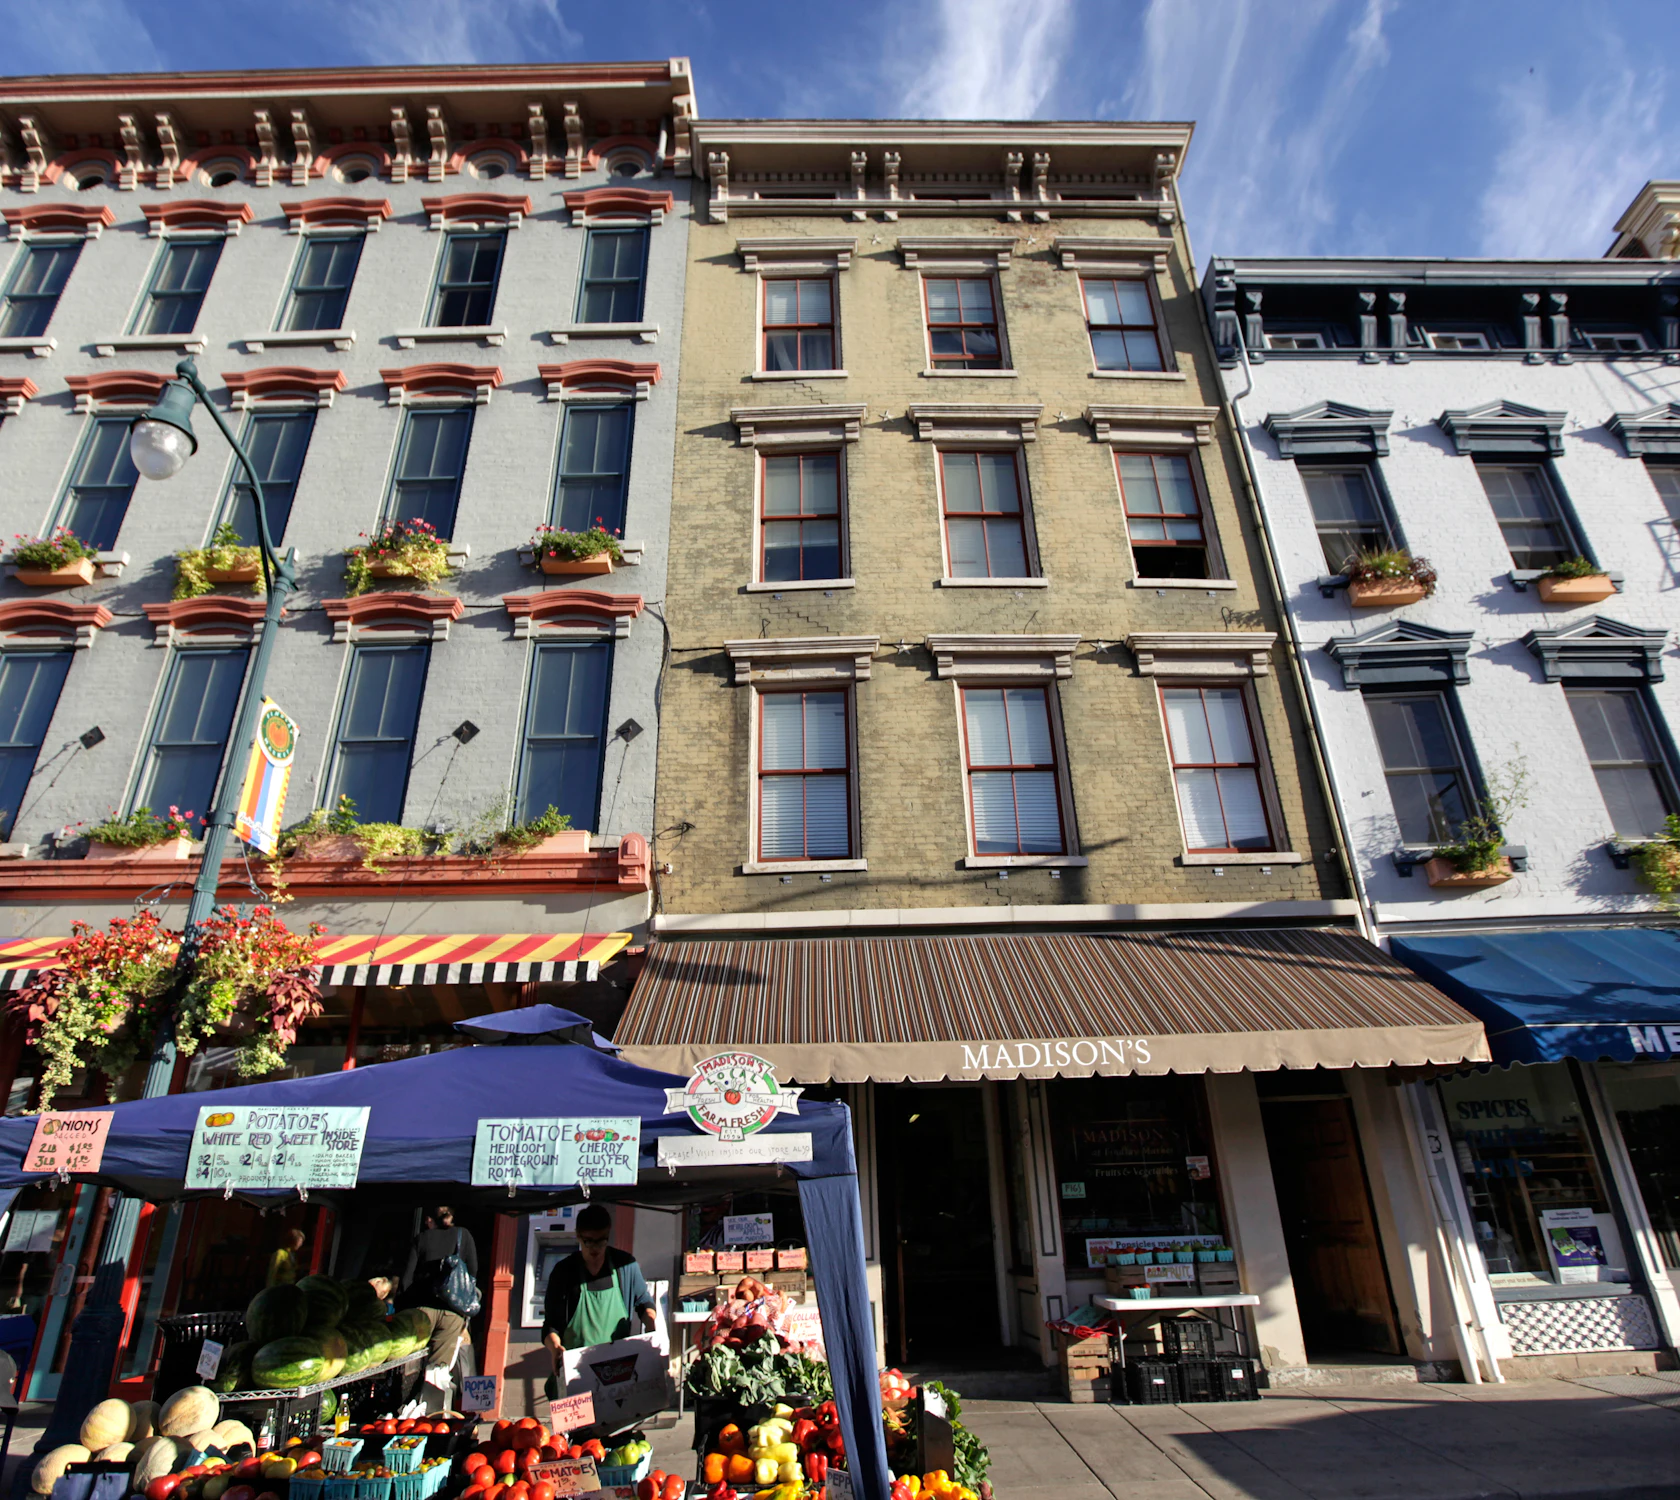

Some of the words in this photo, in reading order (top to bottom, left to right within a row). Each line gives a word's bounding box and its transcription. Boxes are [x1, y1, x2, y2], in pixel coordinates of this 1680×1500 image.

[1627, 1026, 1680, 1052] ME
[961, 1039, 1151, 1069] MADISON'S
[703, 1055, 764, 1074] MADISON'S
[706, 1068, 757, 1086] LOCAL
[697, 1104, 728, 1127] FARM
[730, 1106, 766, 1128] FRESH
[1456, 1098, 1532, 1120] SPICES
[246, 1111, 329, 1132] POTATOES
[202, 1131, 243, 1146] WHITE
[248, 1132, 273, 1150] RED
[276, 1131, 318, 1150] SWEET
[321, 1130, 357, 1146] INSIDE
[486, 1123, 583, 1144] TOMATOES
[326, 1139, 360, 1151] STORE
[490, 1143, 546, 1156] HEIRLOOM
[580, 1142, 624, 1156] CHERRY
[696, 1149, 715, 1160] VISIT
[748, 1149, 766, 1157] OUR
[768, 1147, 789, 1157] STORE
[792, 1145, 811, 1157] ALSO
[488, 1154, 559, 1170] HOMEGROWN
[578, 1154, 632, 1171] CLUSTER
[488, 1167, 523, 1181] ROMA
[577, 1166, 613, 1182] GREEN
[1095, 1167, 1122, 1178] Fruits
[1065, 1184, 1082, 1193] FIGS
[743, 1226, 764, 1236] APPLES
[1157, 1239, 1182, 1248] made
[1202, 1237, 1221, 1247] fruit
[1166, 1265, 1191, 1279] FRUIT
[464, 1379, 496, 1398] ROMA
[551, 1395, 592, 1411] HOMEGROWN
